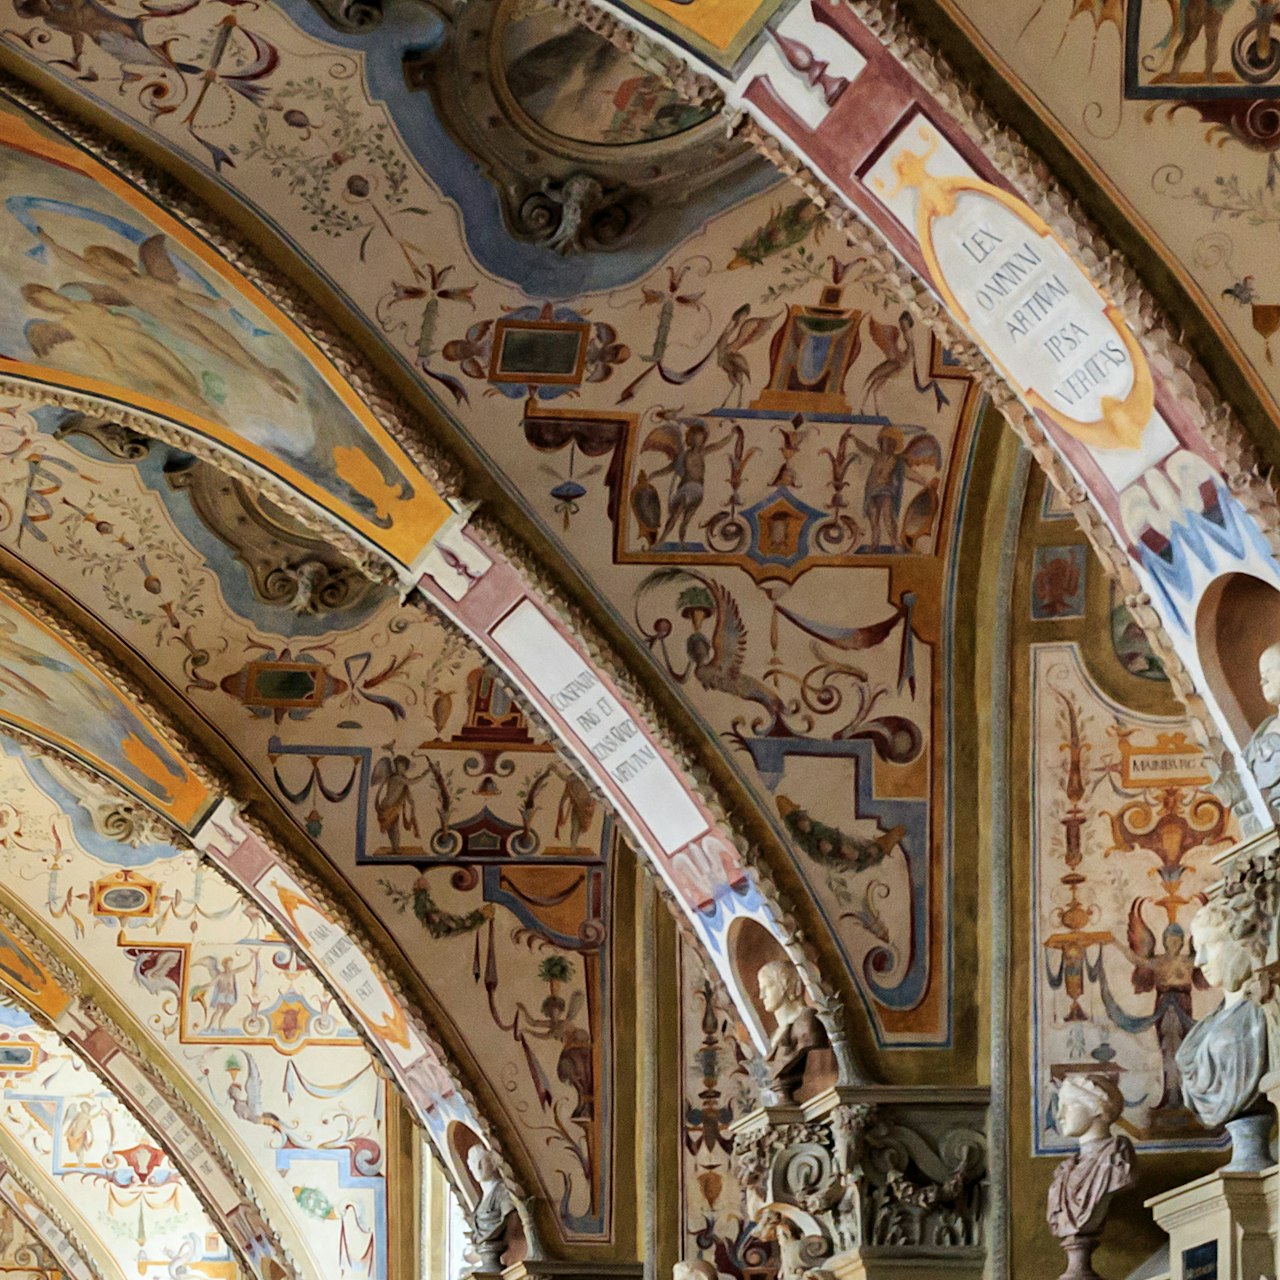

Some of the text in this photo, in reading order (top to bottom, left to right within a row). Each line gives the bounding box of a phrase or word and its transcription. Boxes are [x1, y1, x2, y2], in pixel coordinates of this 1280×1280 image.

[962, 229, 1002, 264] LEX
[976, 243, 1044, 313] OMNIVM
[1005, 275, 1069, 343] ARTIVM
[1043, 323, 1089, 363] IPSA
[1053, 341, 1126, 406] VERITAS
